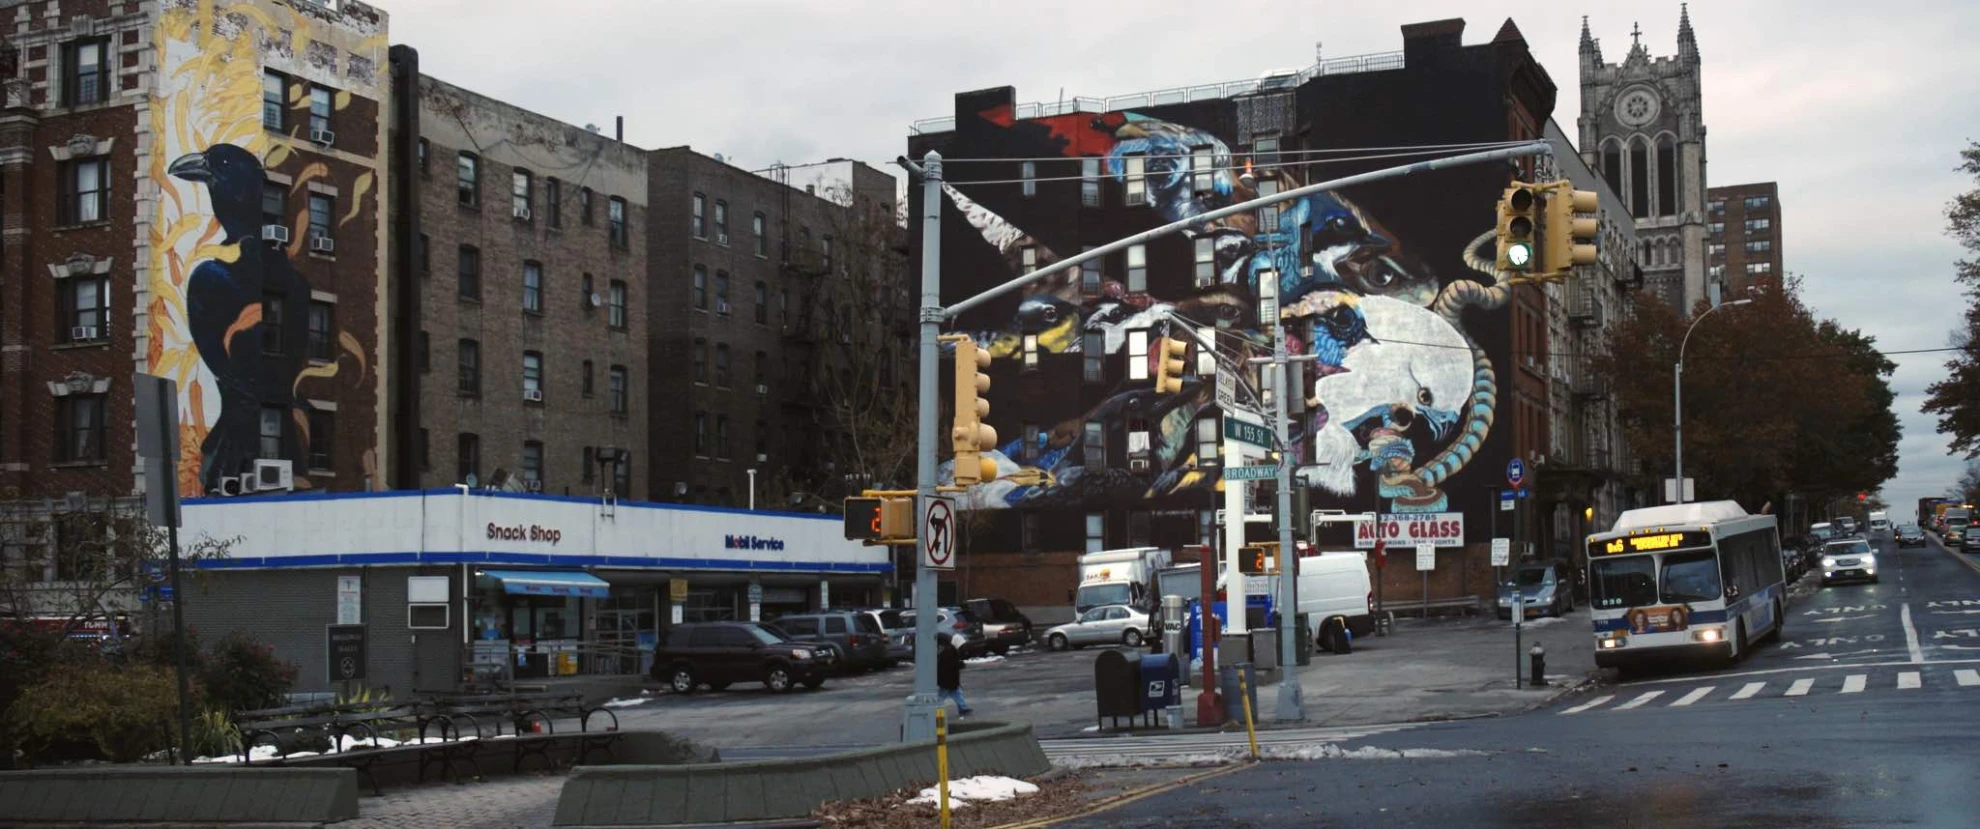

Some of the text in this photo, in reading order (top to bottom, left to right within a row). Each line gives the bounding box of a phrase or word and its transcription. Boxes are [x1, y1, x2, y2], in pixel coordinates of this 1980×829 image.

[1234, 422, 1242, 437] W
[1243, 425, 1255, 442] 155
[1224, 467, 1275, 479] BROADWAY
[486, 521, 561, 545] Snack Shop
[1408, 520, 1461, 538] GLASS
[725, 534, 784, 551] Mobil Service
[1164, 622, 1182, 631] VAC
